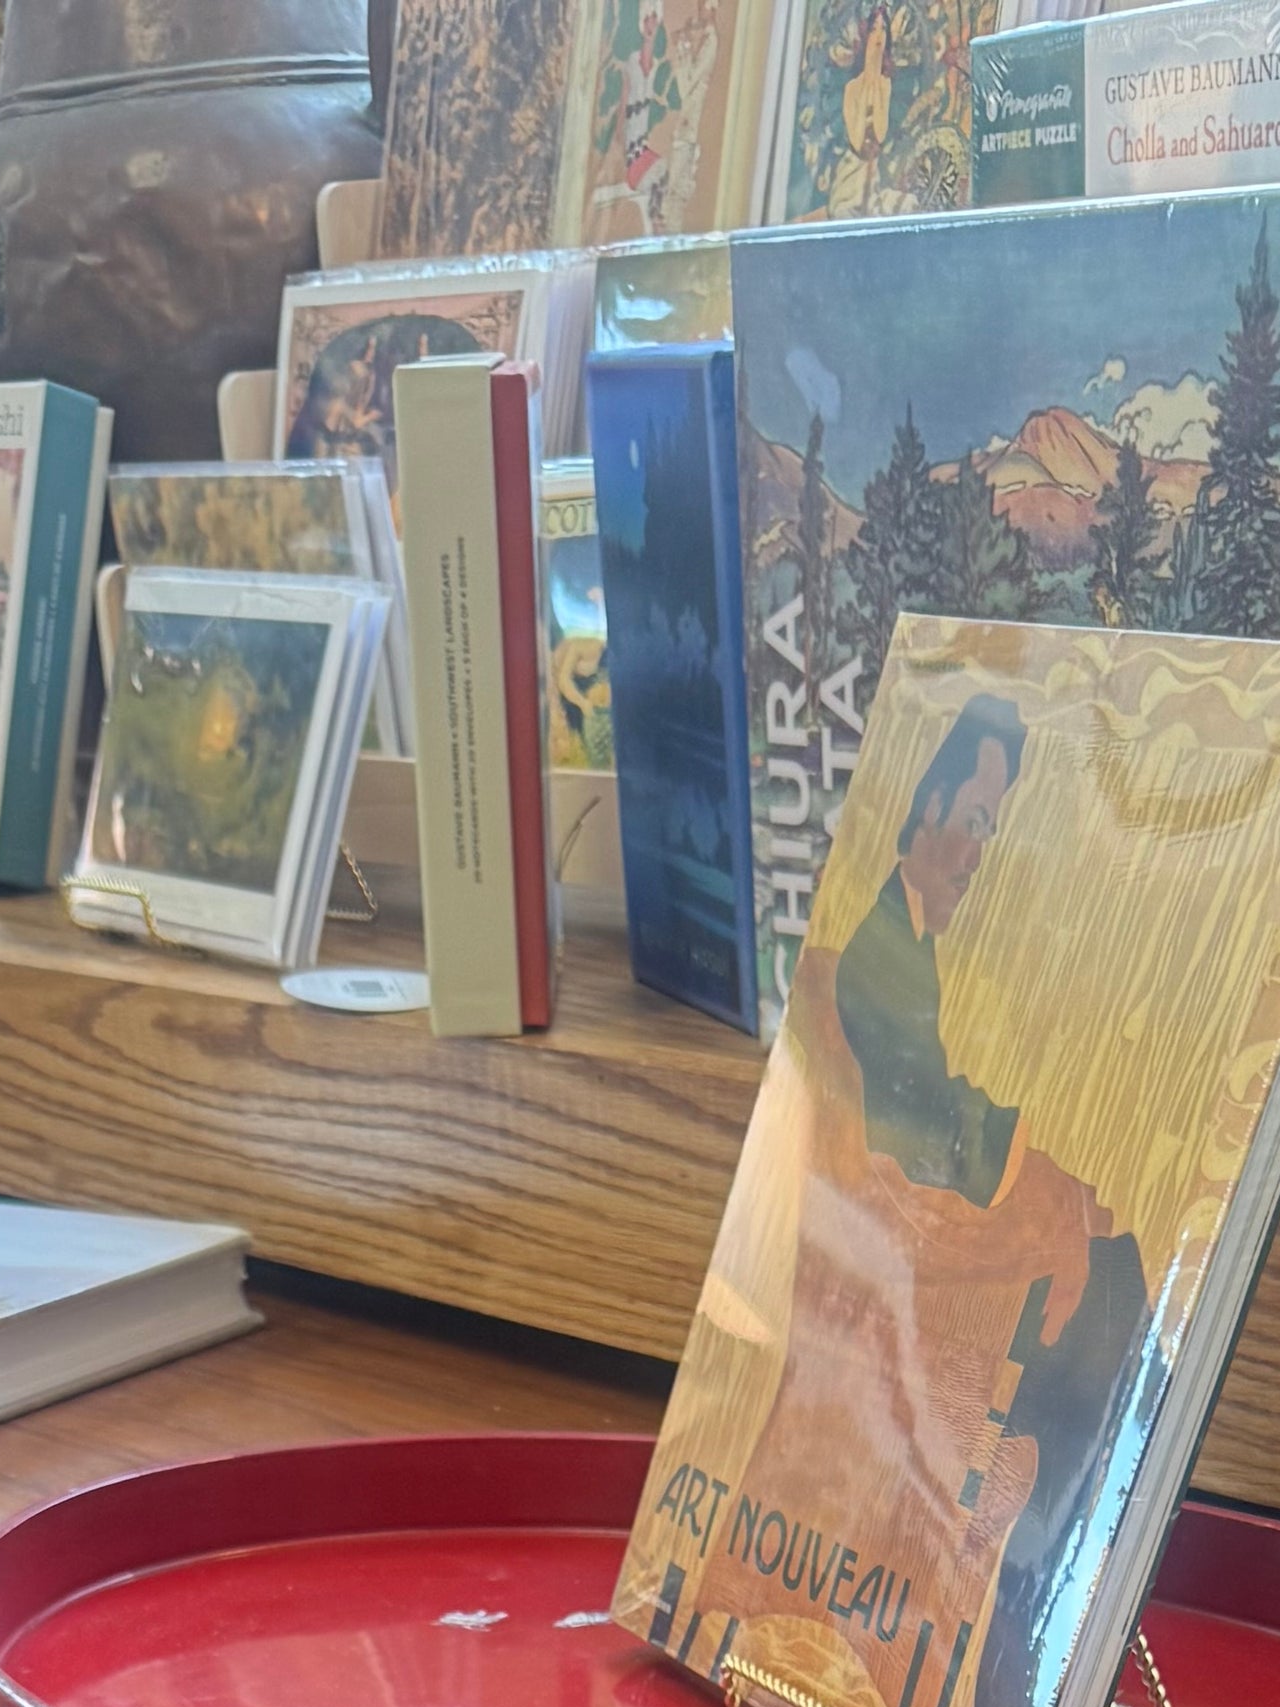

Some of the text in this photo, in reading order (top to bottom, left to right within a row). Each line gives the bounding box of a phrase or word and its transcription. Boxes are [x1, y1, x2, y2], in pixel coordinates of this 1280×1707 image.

[1105, 67, 1184, 104] GUSTAVE
[1035, 122, 1077, 146] PUZZLE
[1108, 124, 1166, 166] Cholla
[1171, 135, 1198, 158] and
[440, 554, 455, 643] LANDSCAPES
[445, 648, 459, 729] SOUTHWEST
[655, 1462, 911, 1643] ART NOUVEAU
